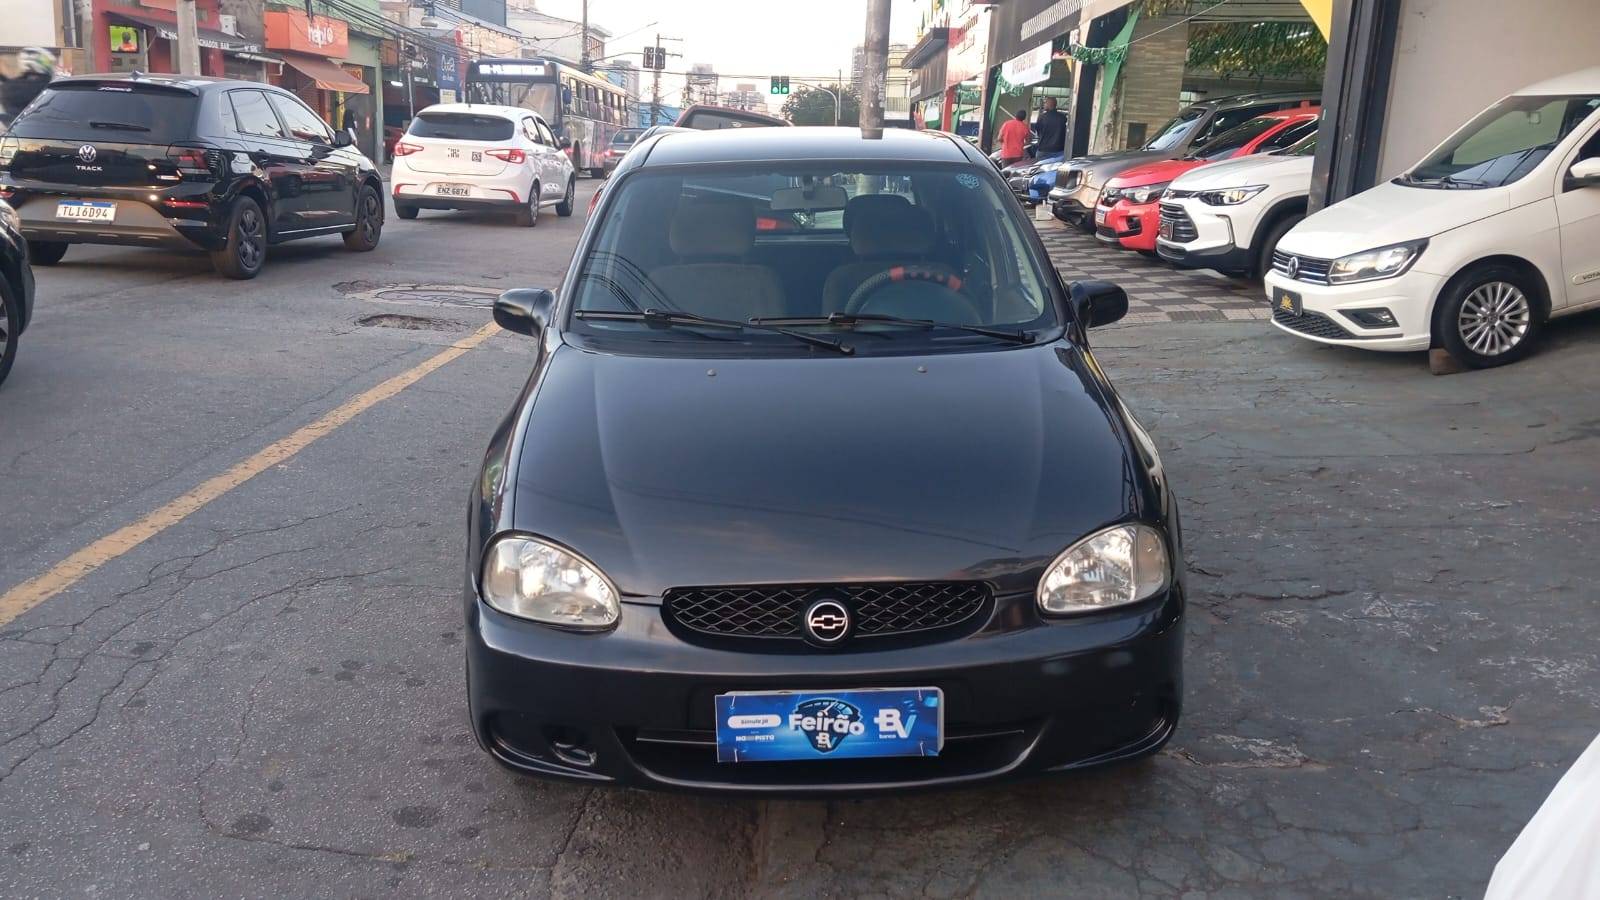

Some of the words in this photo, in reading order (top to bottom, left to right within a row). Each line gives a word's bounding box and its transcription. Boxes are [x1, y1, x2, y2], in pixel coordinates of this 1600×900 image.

[63, 206, 108, 218] TLI6D94
[789, 711, 865, 736] Feirão
[874, 708, 917, 739] BV
